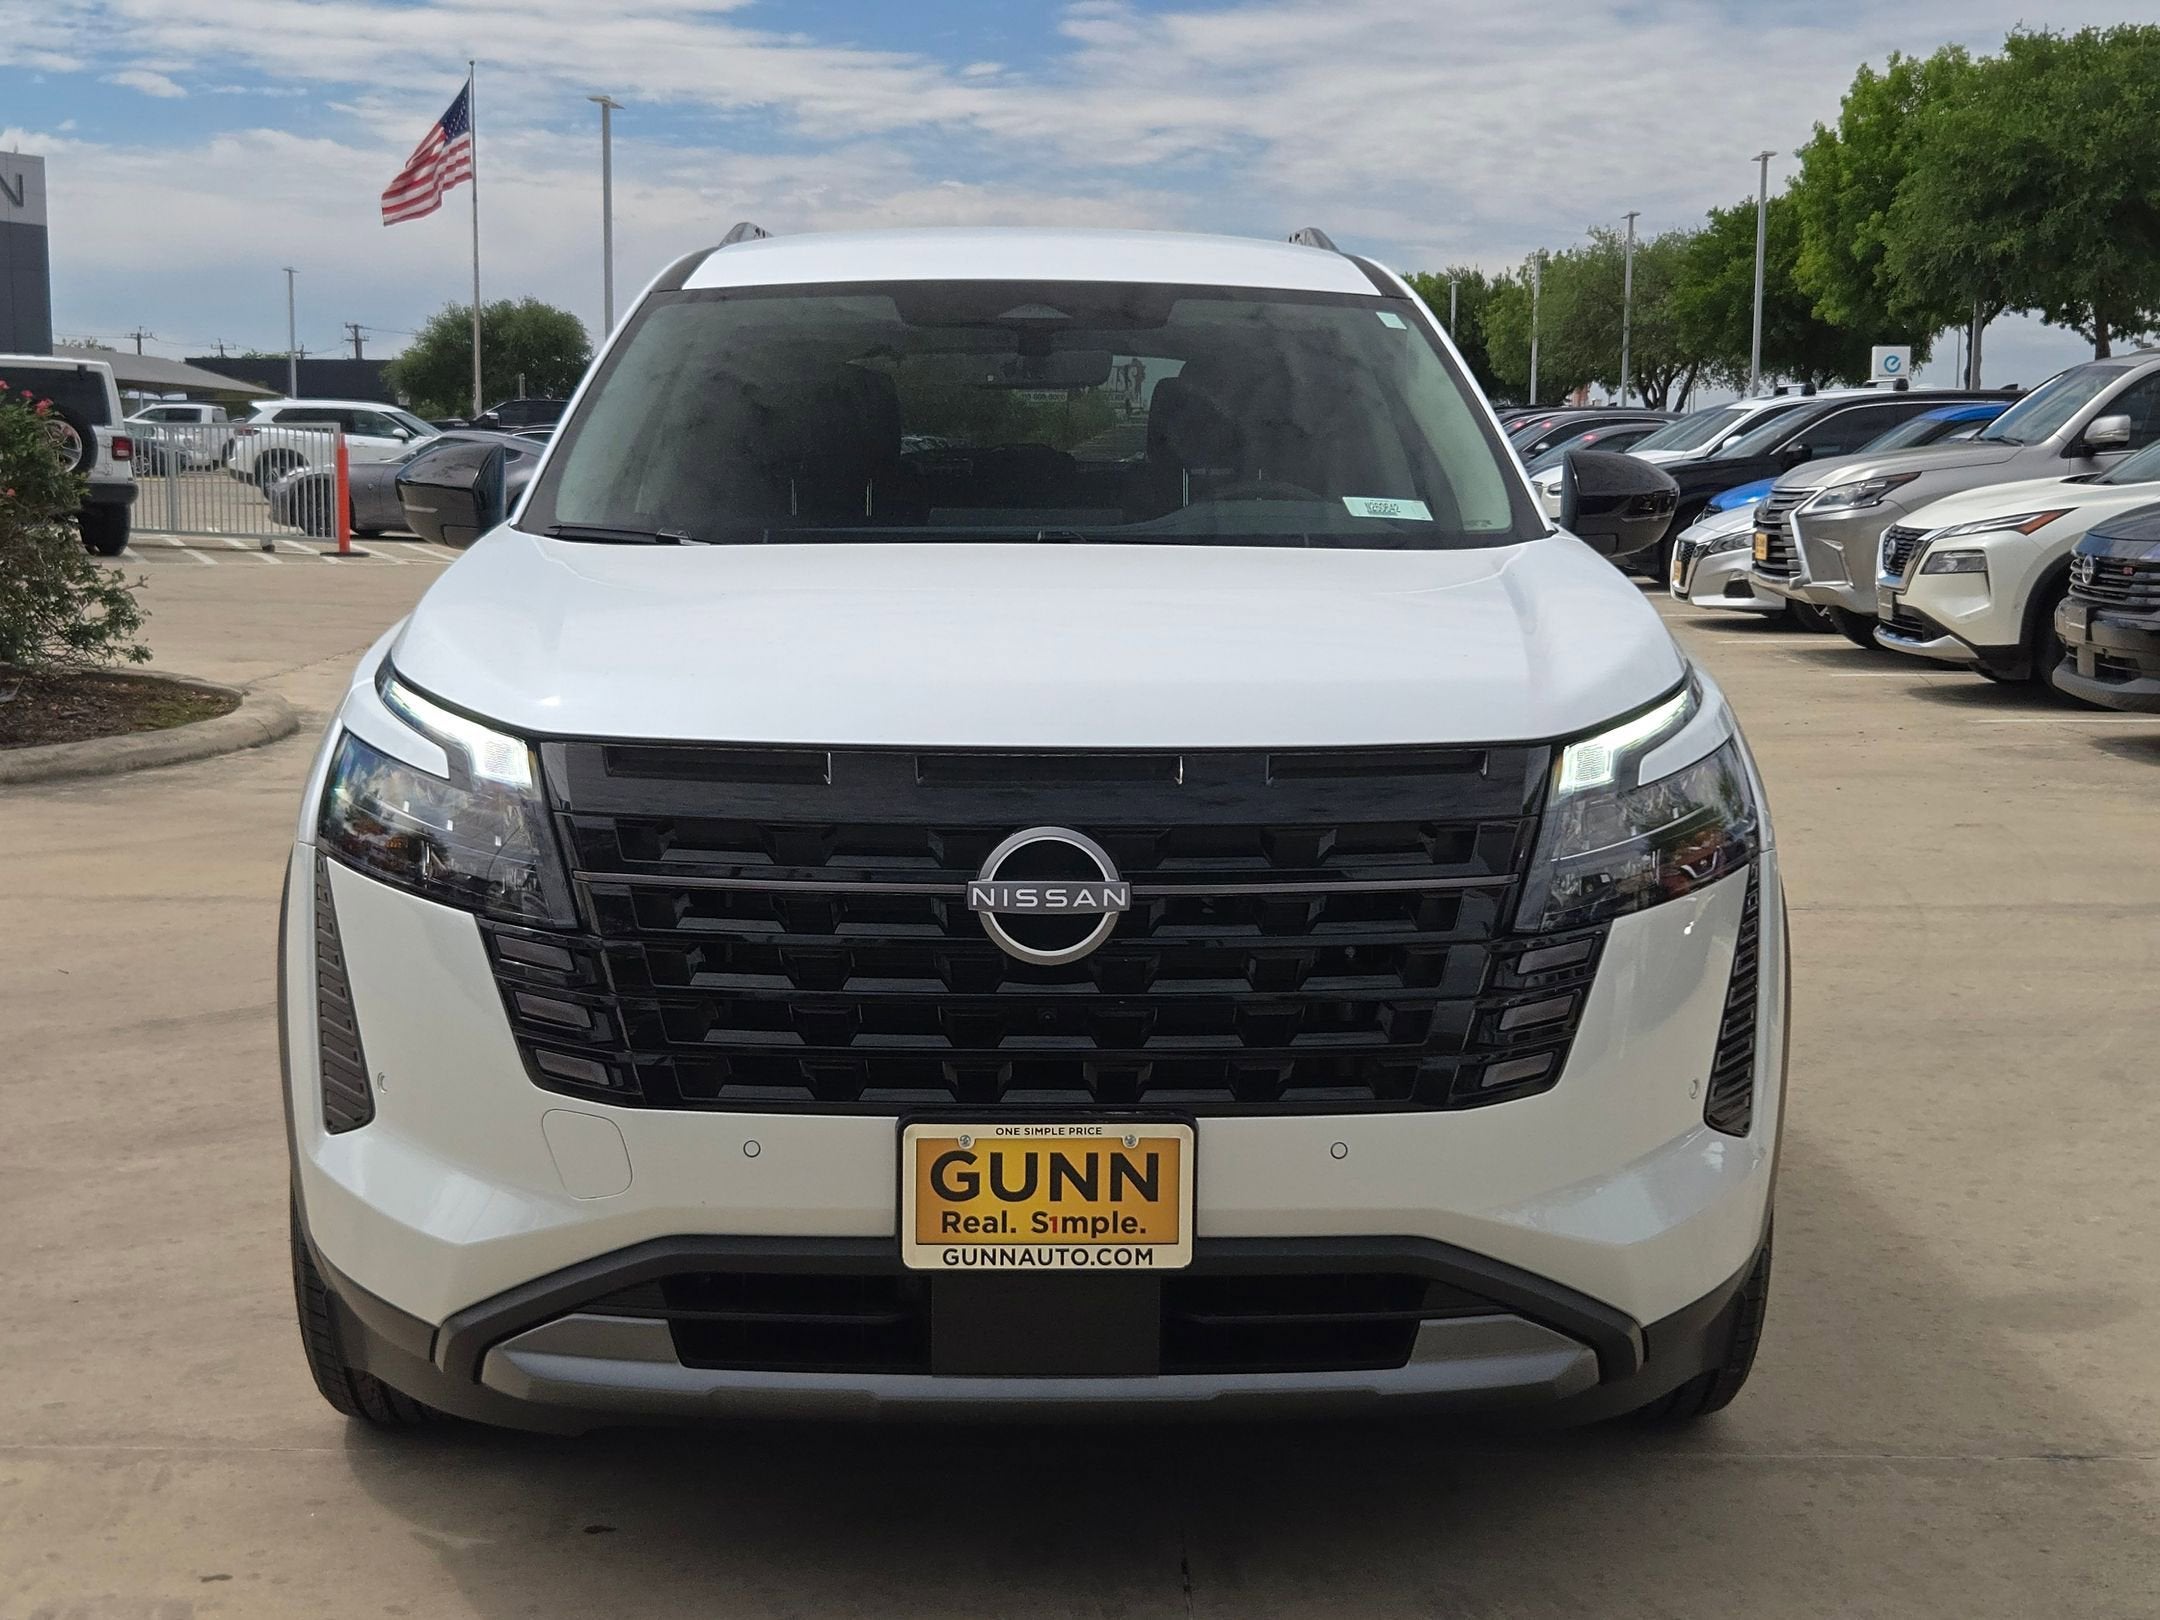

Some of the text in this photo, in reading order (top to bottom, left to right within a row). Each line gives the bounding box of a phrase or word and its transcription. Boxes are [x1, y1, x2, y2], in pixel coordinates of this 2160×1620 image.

[972, 887, 1126, 908] NISSAN
[995, 1127, 1102, 1136] ONE SIMPLE PRICE
[930, 1150, 1159, 1203] GUNN
[941, 1210, 1017, 1234] Real.
[942, 1248, 1153, 1266] GUNNAUTO.COM
